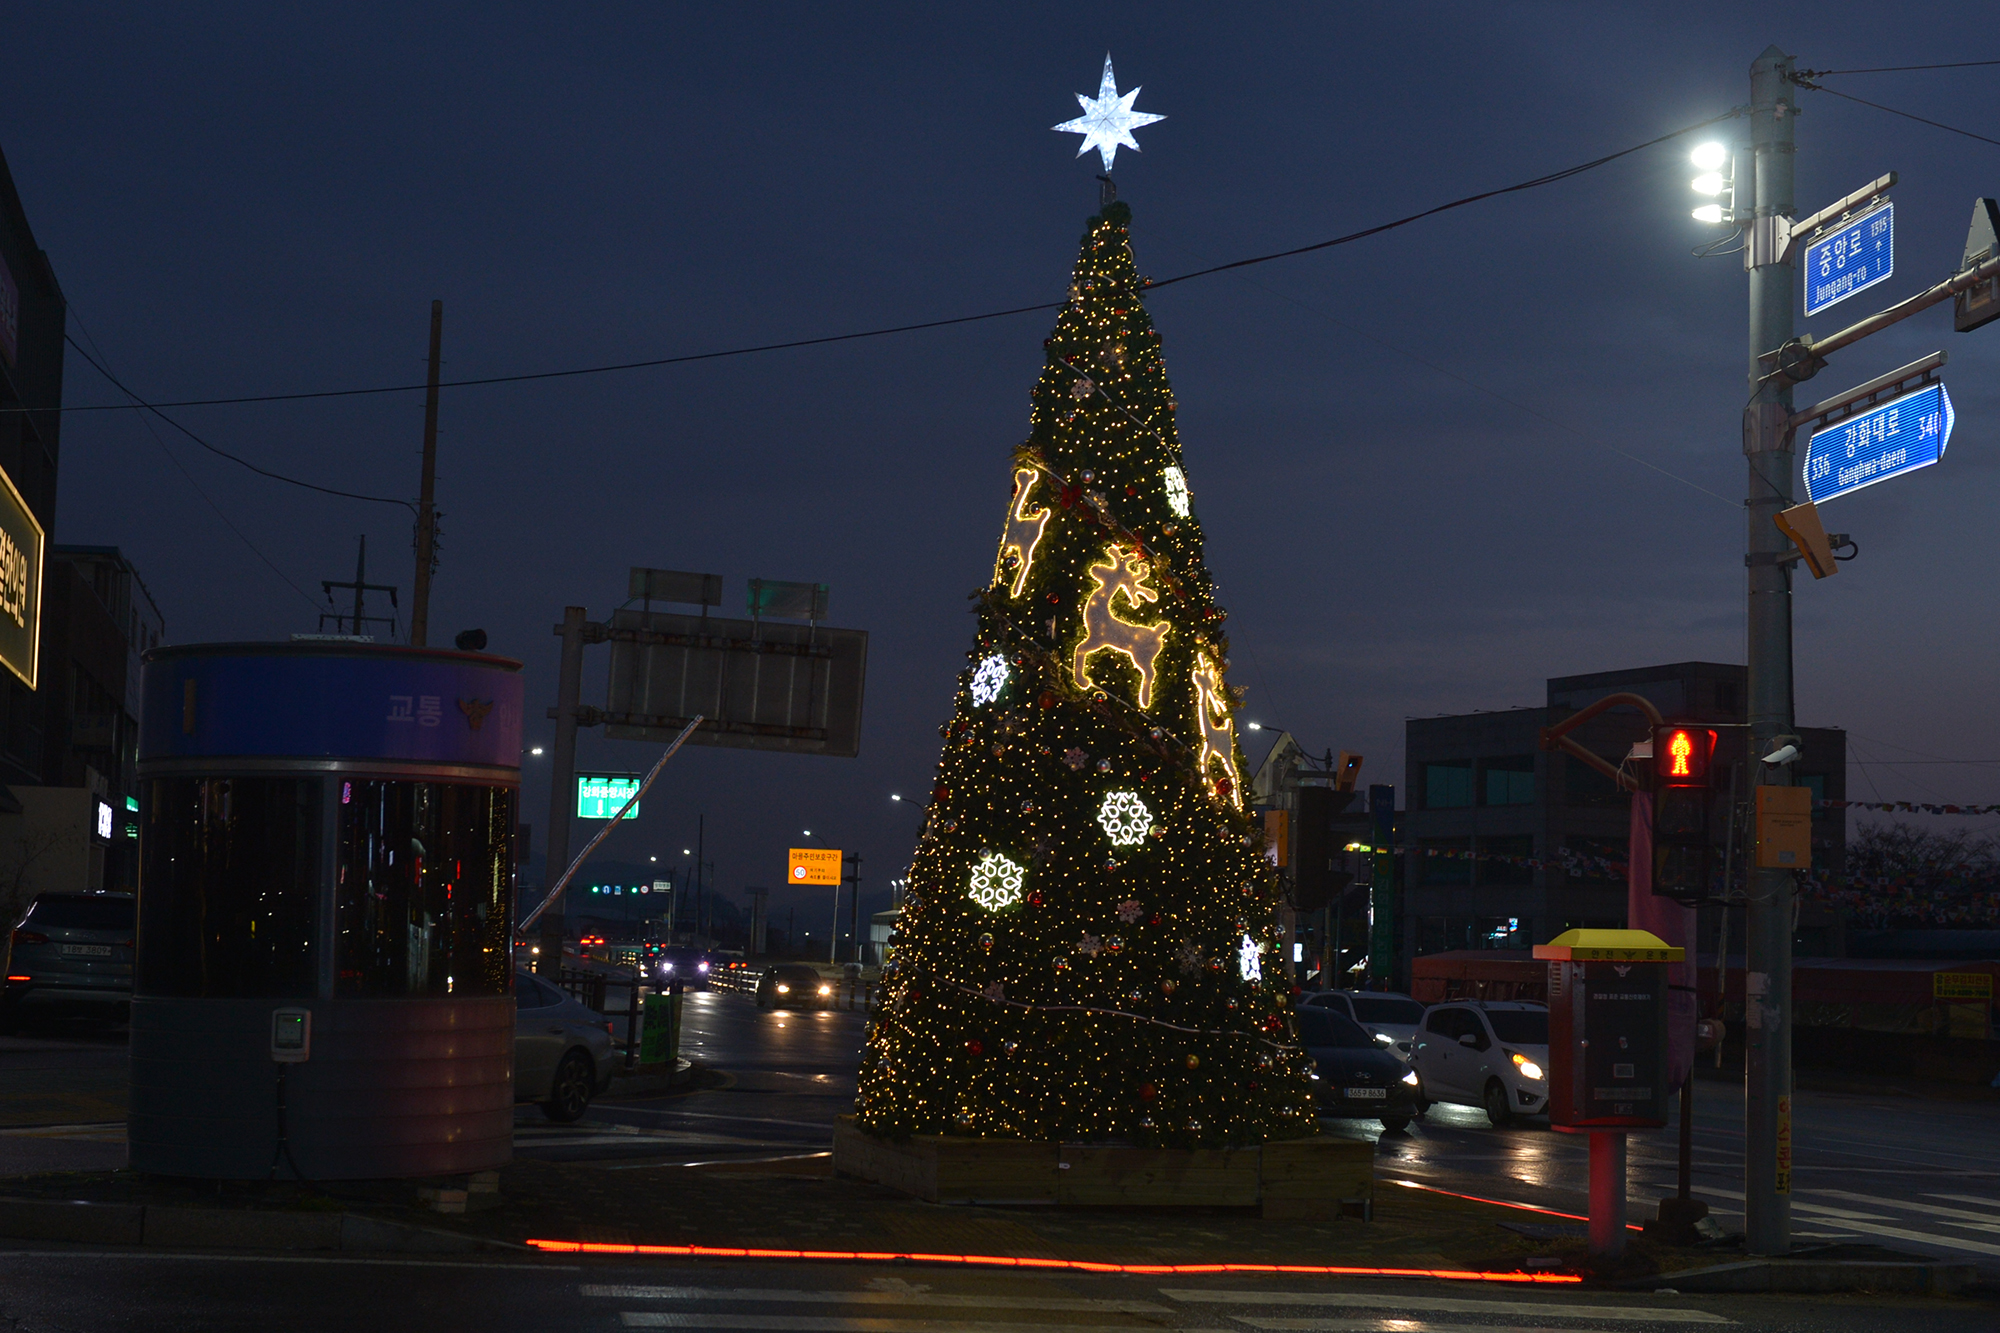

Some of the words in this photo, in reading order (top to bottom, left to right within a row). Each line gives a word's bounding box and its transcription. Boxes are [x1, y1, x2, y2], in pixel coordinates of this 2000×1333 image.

[1819, 229, 1863, 277] 중앙로
[1876, 257, 1882, 271] 1
[1814, 265, 1867, 304] Jungang-ro
[1845, 408, 1900, 458] 강화대로
[1812, 453, 1830, 480] 336
[1838, 448, 1906, 486] Ganghwa-daero
[386, 695, 443, 727] 교통
[1376, 798, 1393, 807] NH
[796, 868, 805, 877] 50
[86, 946, 108, 955] 3809
[1591, 949, 1614, 960] 안전
[1646, 950, 1668, 960] 운행
